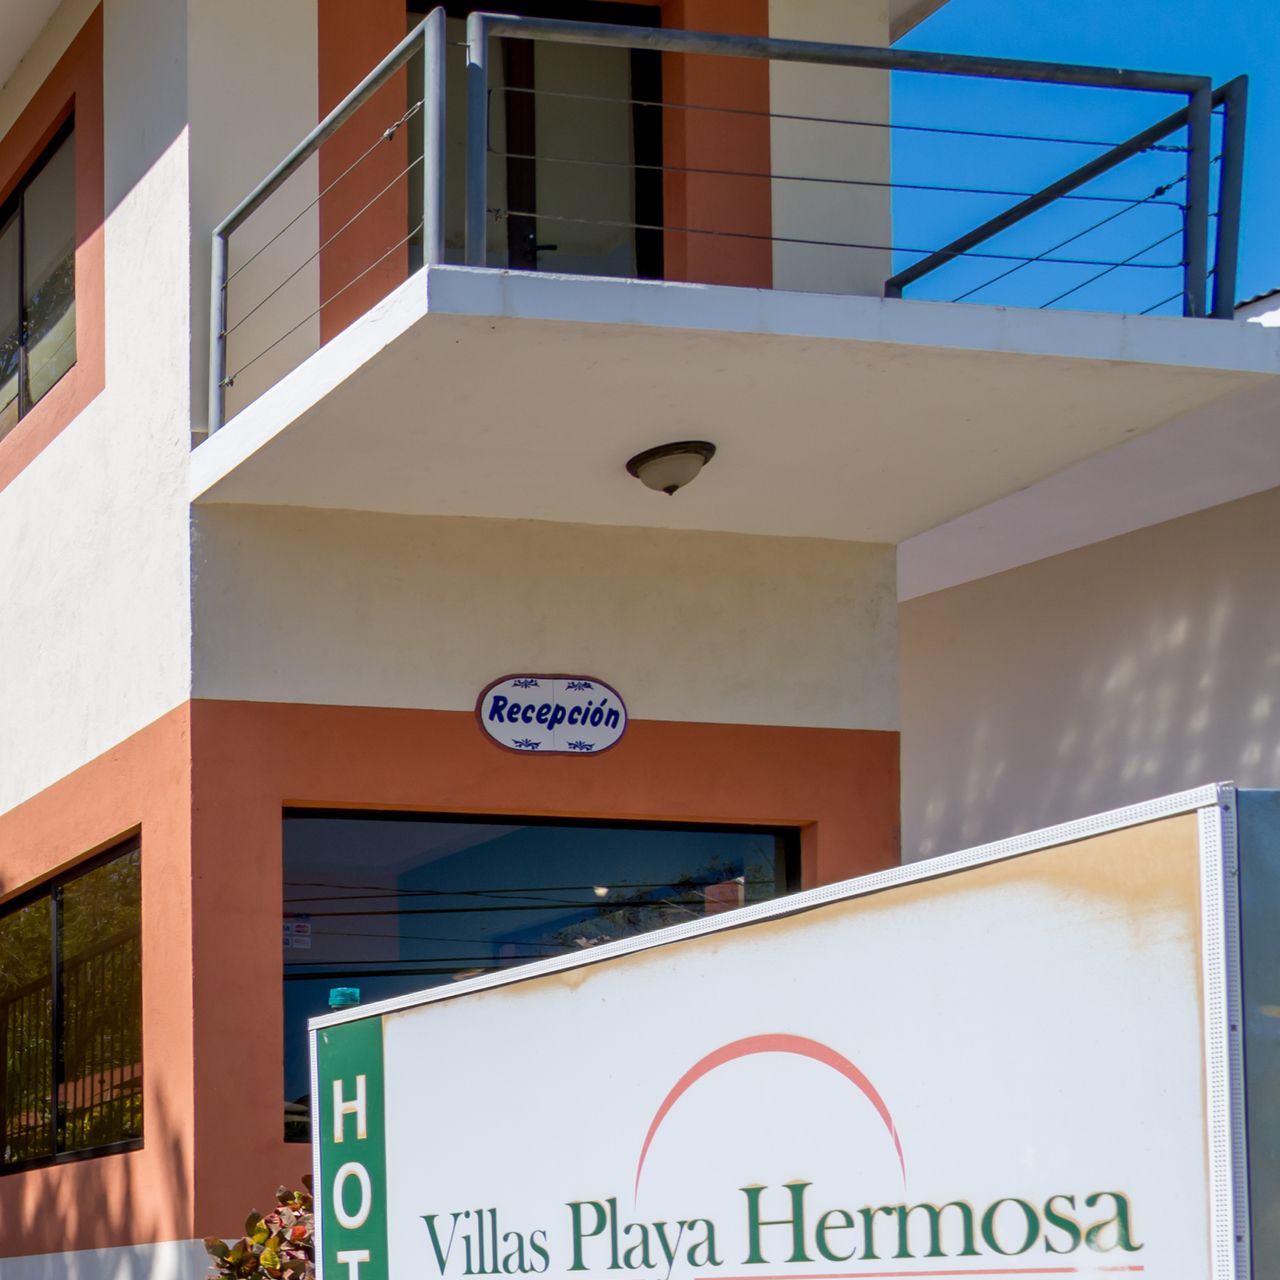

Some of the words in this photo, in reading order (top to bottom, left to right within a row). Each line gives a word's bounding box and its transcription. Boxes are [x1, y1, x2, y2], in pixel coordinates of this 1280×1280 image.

[488, 695, 620, 731] Recepción
[419, 1208, 551, 1277] Villas
[738, 1179, 1145, 1265] Hermosa
